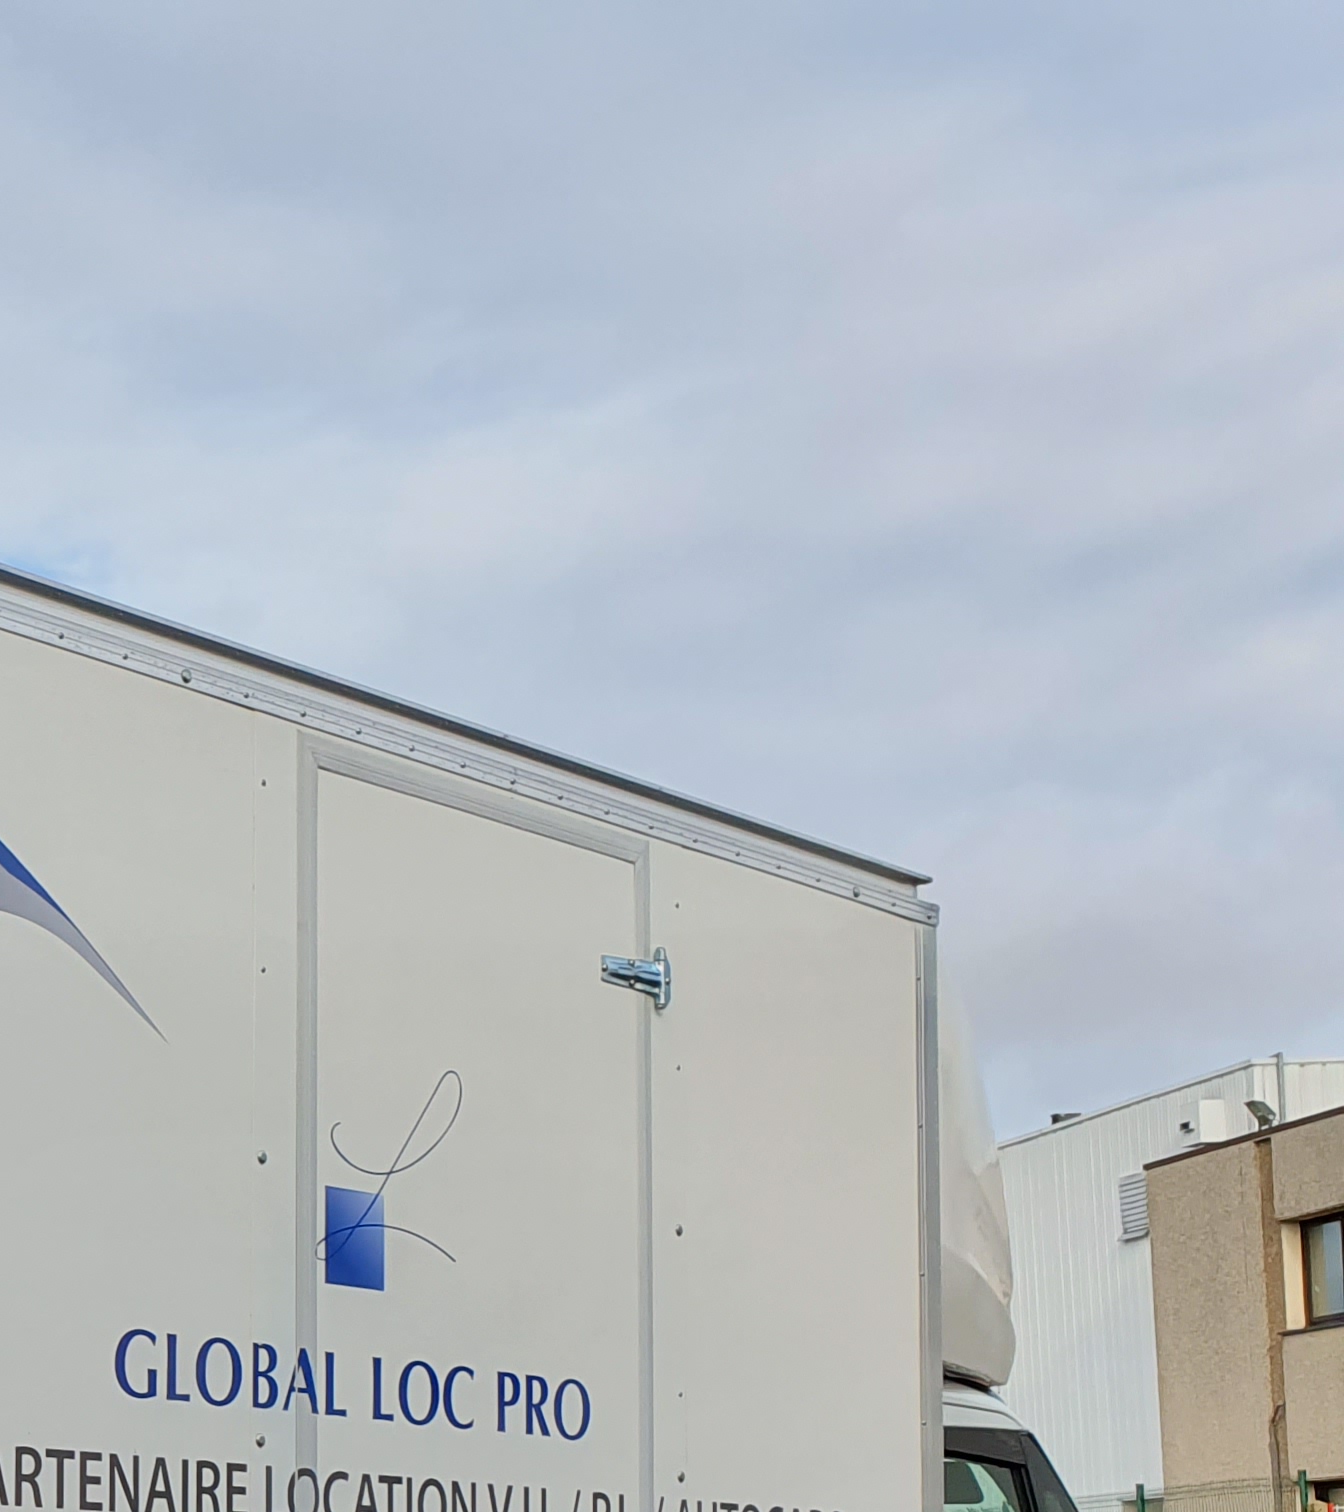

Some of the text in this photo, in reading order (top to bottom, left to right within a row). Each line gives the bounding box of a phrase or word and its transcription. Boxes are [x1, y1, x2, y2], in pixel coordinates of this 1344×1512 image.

[114, 1328, 591, 1441] GLOBAL LOC PRO
